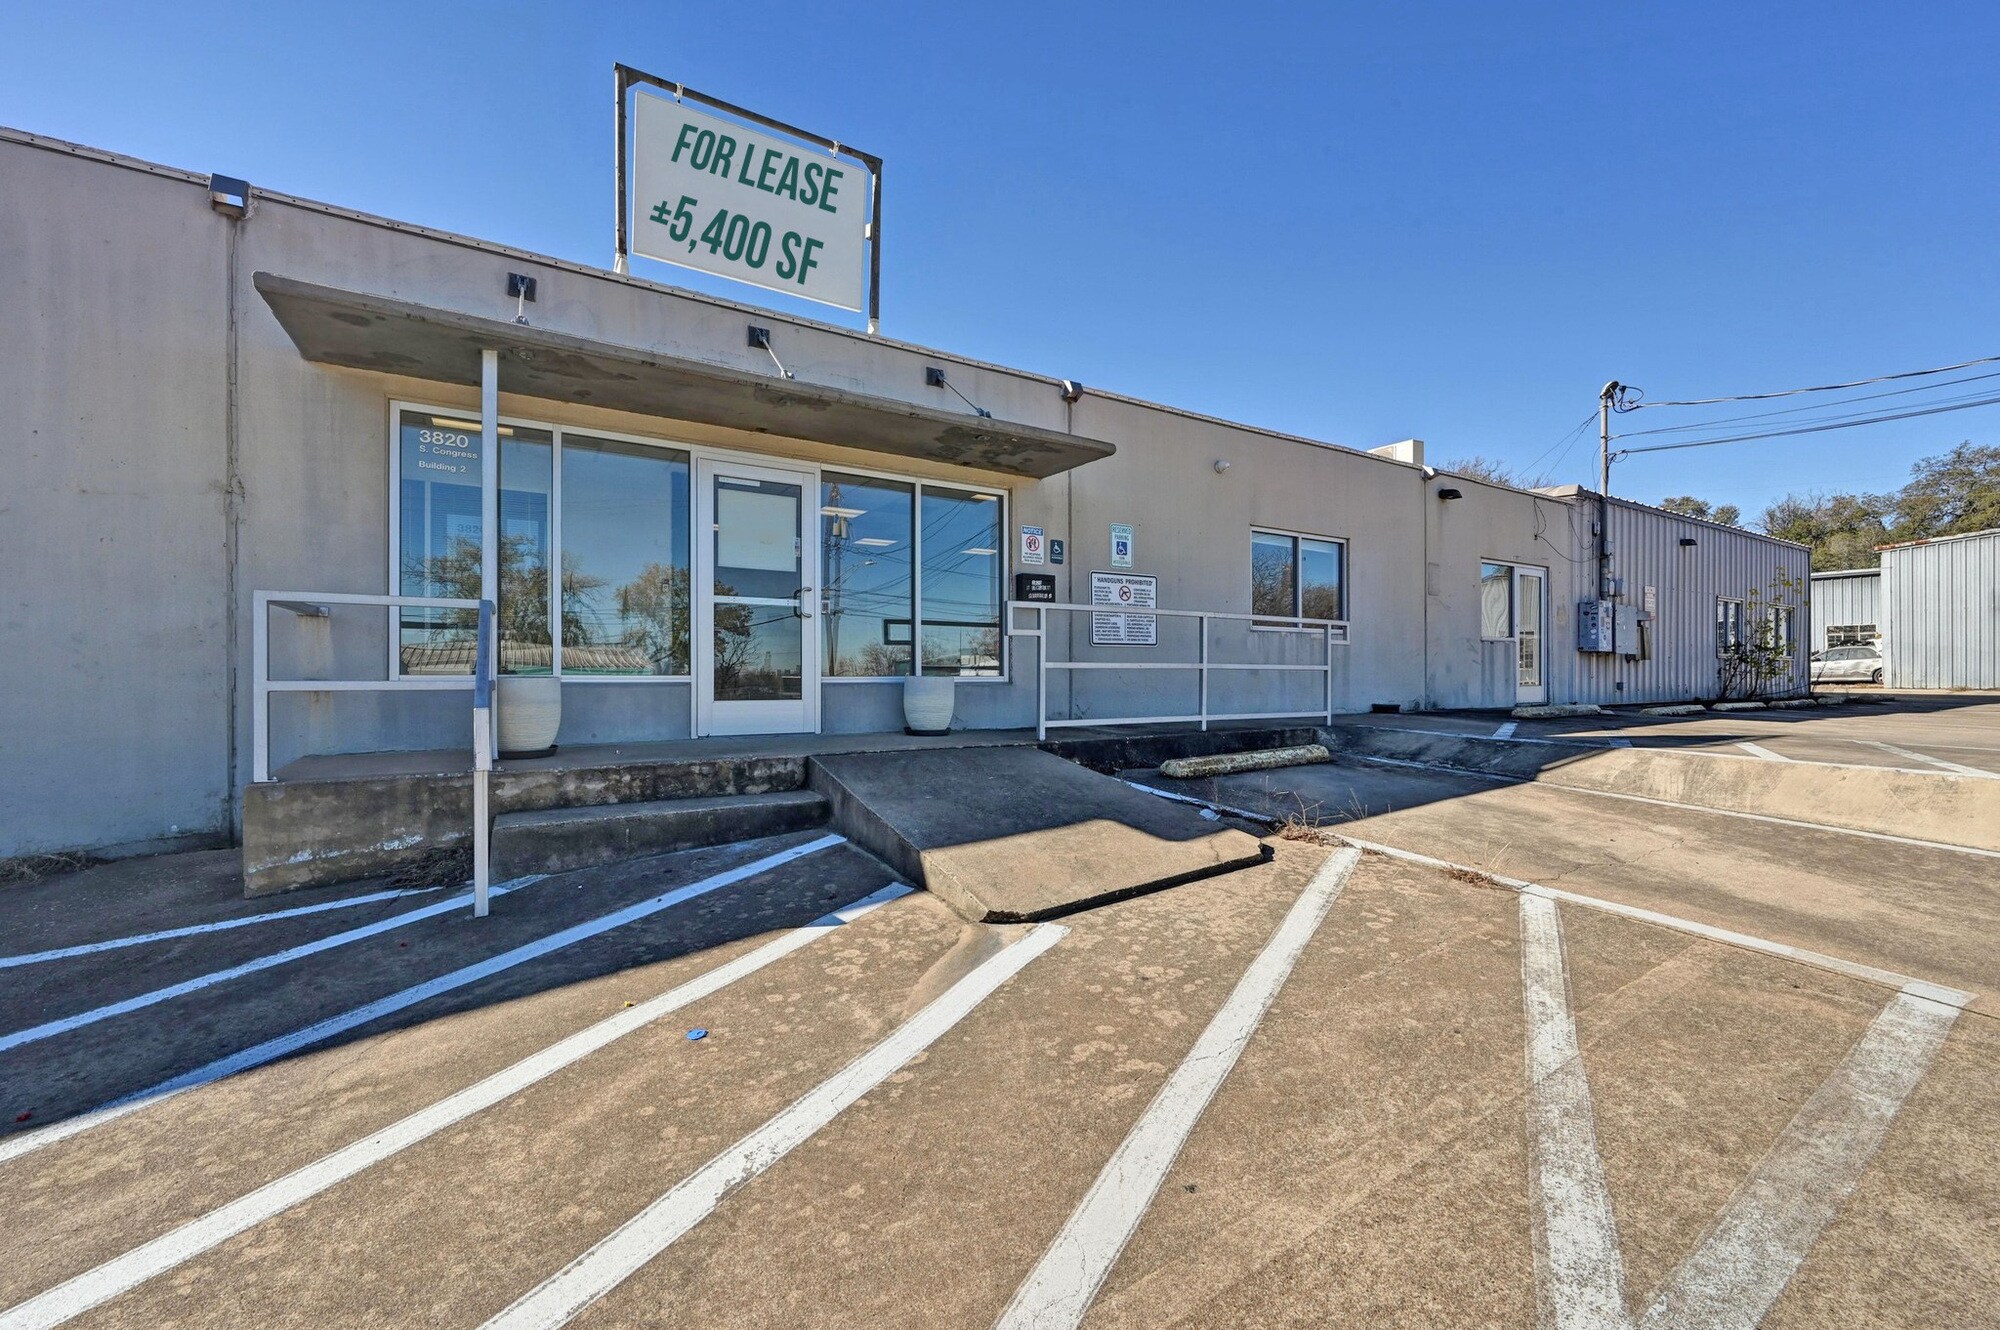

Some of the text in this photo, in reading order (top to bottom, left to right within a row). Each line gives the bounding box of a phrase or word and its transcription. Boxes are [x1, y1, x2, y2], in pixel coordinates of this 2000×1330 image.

[671, 123, 844, 214] FOR LEASE
[649, 195, 824, 285] ±5,400 SF
[420, 430, 469, 448] 3820
[419, 445, 478, 459] S. Congress
[419, 460, 467, 473] Building 2
[1022, 528, 1043, 536] NOTICE
[1097, 577, 1153, 587] HANDGUNS PROHIBITED
